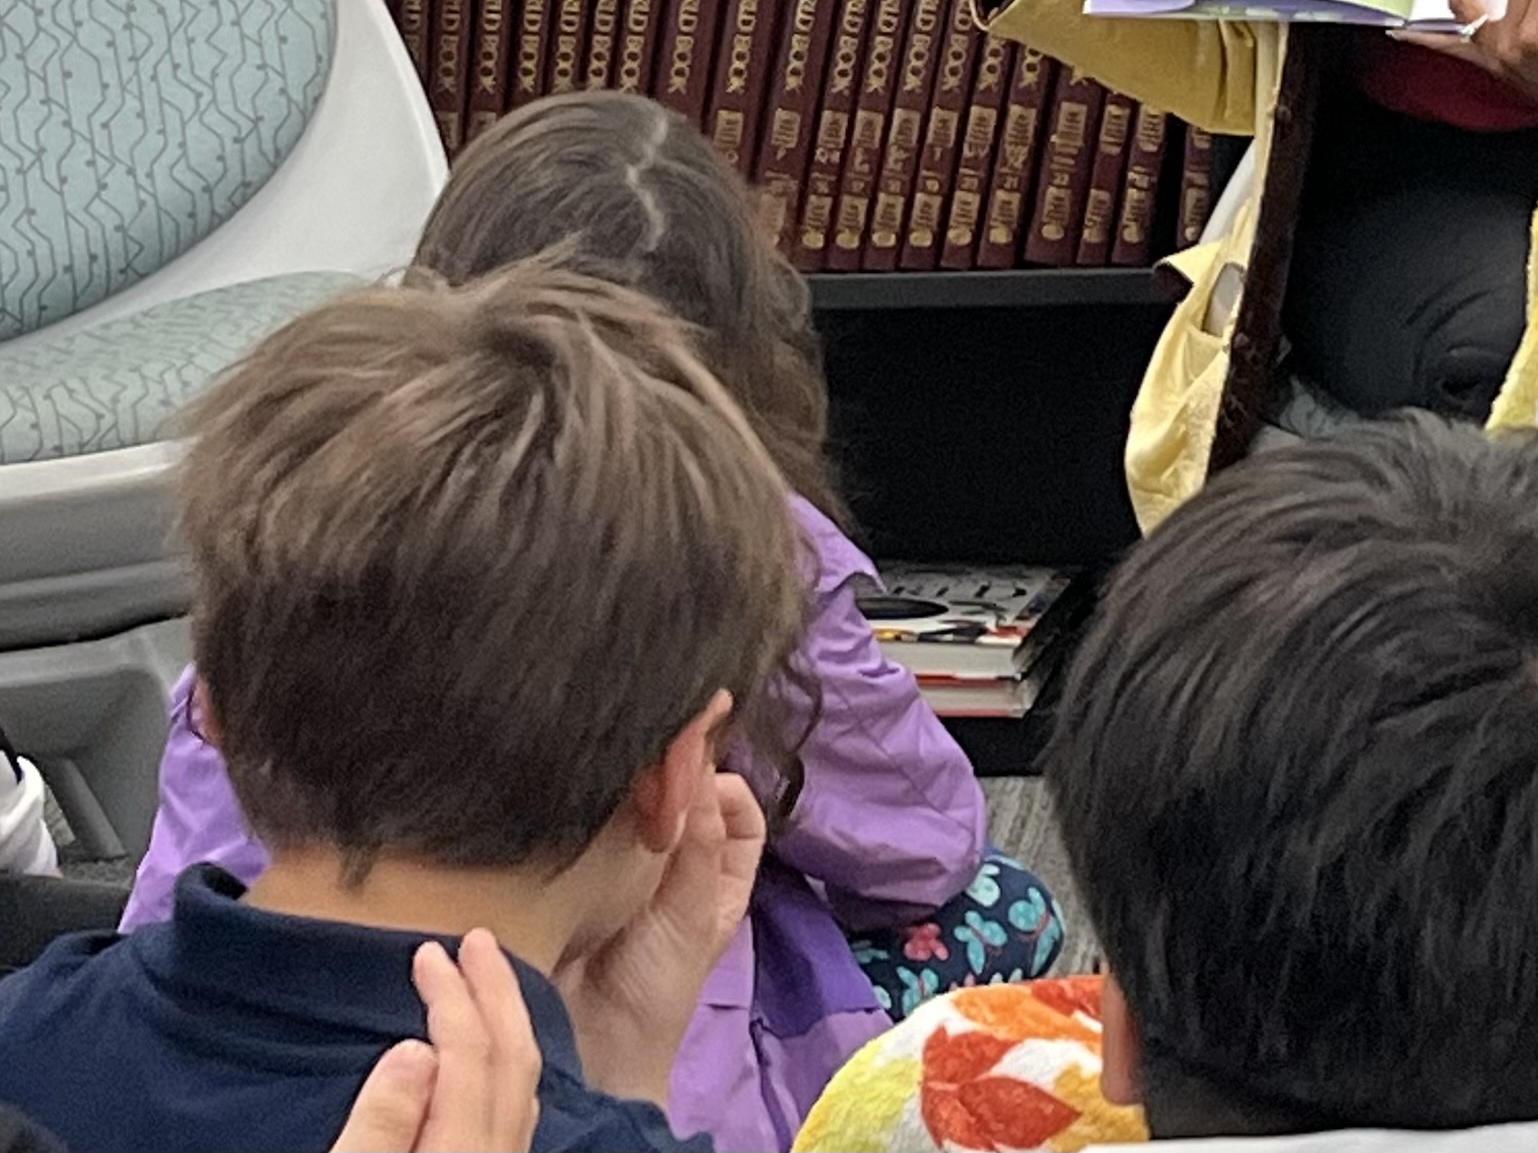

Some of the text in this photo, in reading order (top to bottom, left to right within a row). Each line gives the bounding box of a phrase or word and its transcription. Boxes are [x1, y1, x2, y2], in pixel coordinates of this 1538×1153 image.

[437, 35, 458, 93] BOOK
[478, 35, 498, 93] BOOK
[518, 35, 540, 93] BOOK
[667, 35, 694, 94] BOOK
[725, 35, 752, 94] BOOK
[784, 35, 811, 93] BOOK
[831, 36, 858, 94] BOOK
[866, 35, 894, 94] BOOK
[903, 35, 931, 93] BOOK
[942, 35, 969, 93] BOOK
